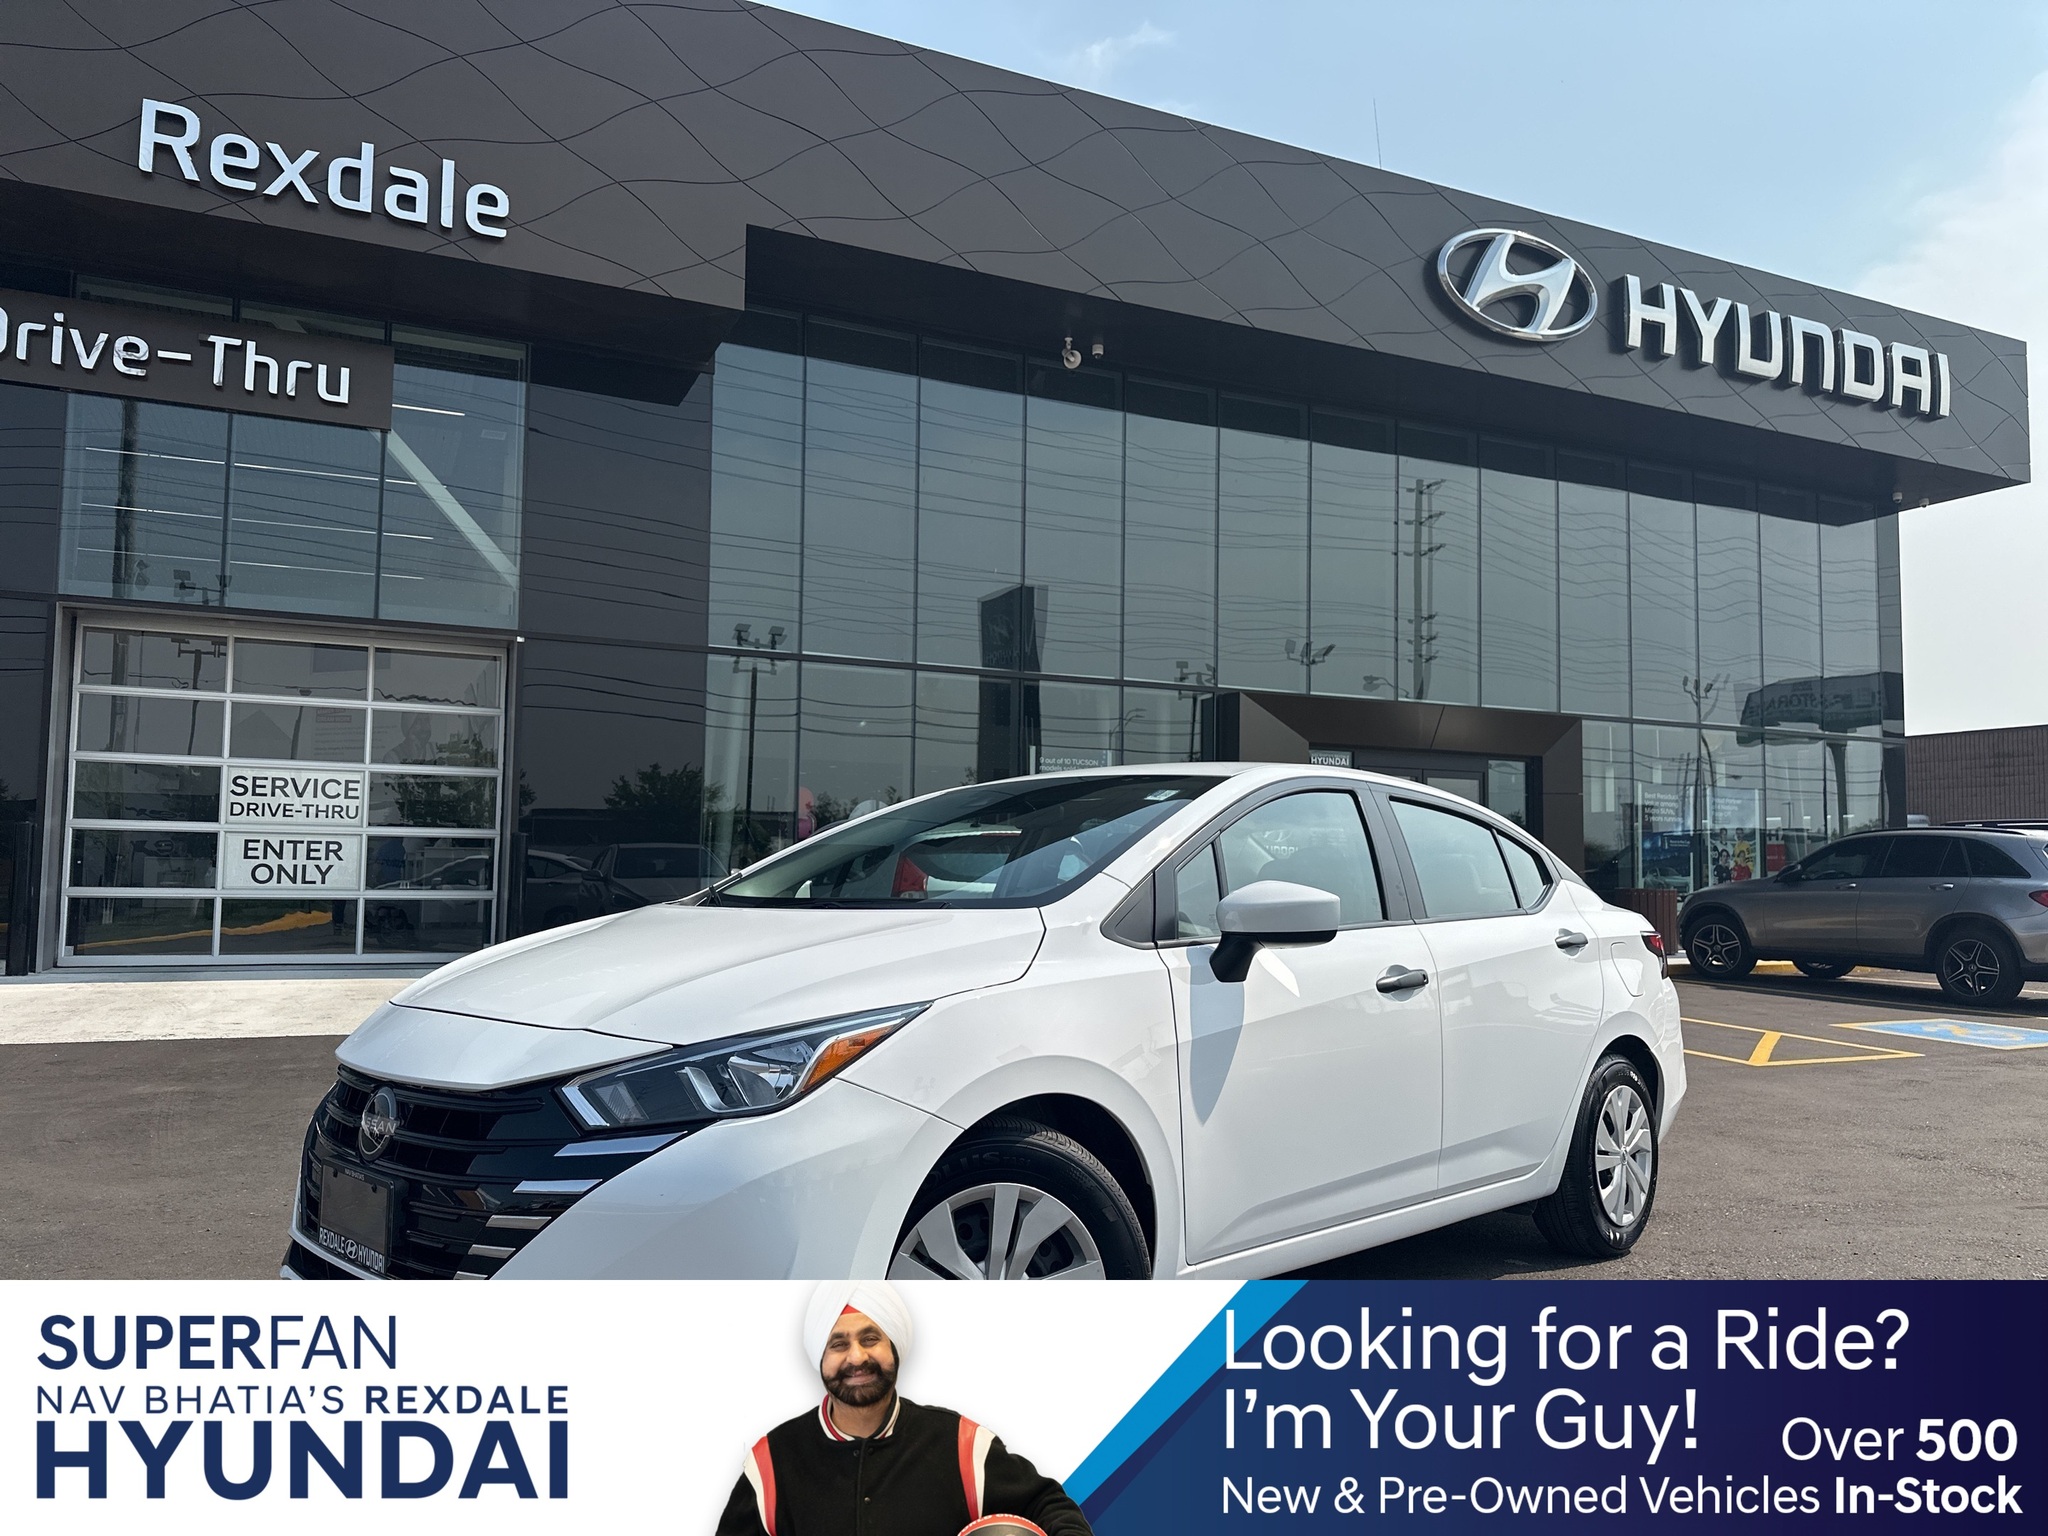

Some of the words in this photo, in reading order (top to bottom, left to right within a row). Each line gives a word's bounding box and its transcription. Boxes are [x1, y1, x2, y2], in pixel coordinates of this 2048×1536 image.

[138, 98, 510, 238] Rexdale
[1622, 274, 1951, 418] HYUNDAI
[1072, 758, 1099, 767] TUCSON
[1310, 755, 1350, 767] HYUNDAI
[230, 775, 361, 800] SERVICE
[229, 802, 359, 820] DRIVE-THRU
[243, 838, 344, 862] ENTER
[251, 863, 335, 885] ONLY
[319, 1227, 345, 1253] REXDALE
[358, 1243, 385, 1274] HYUNDAI
